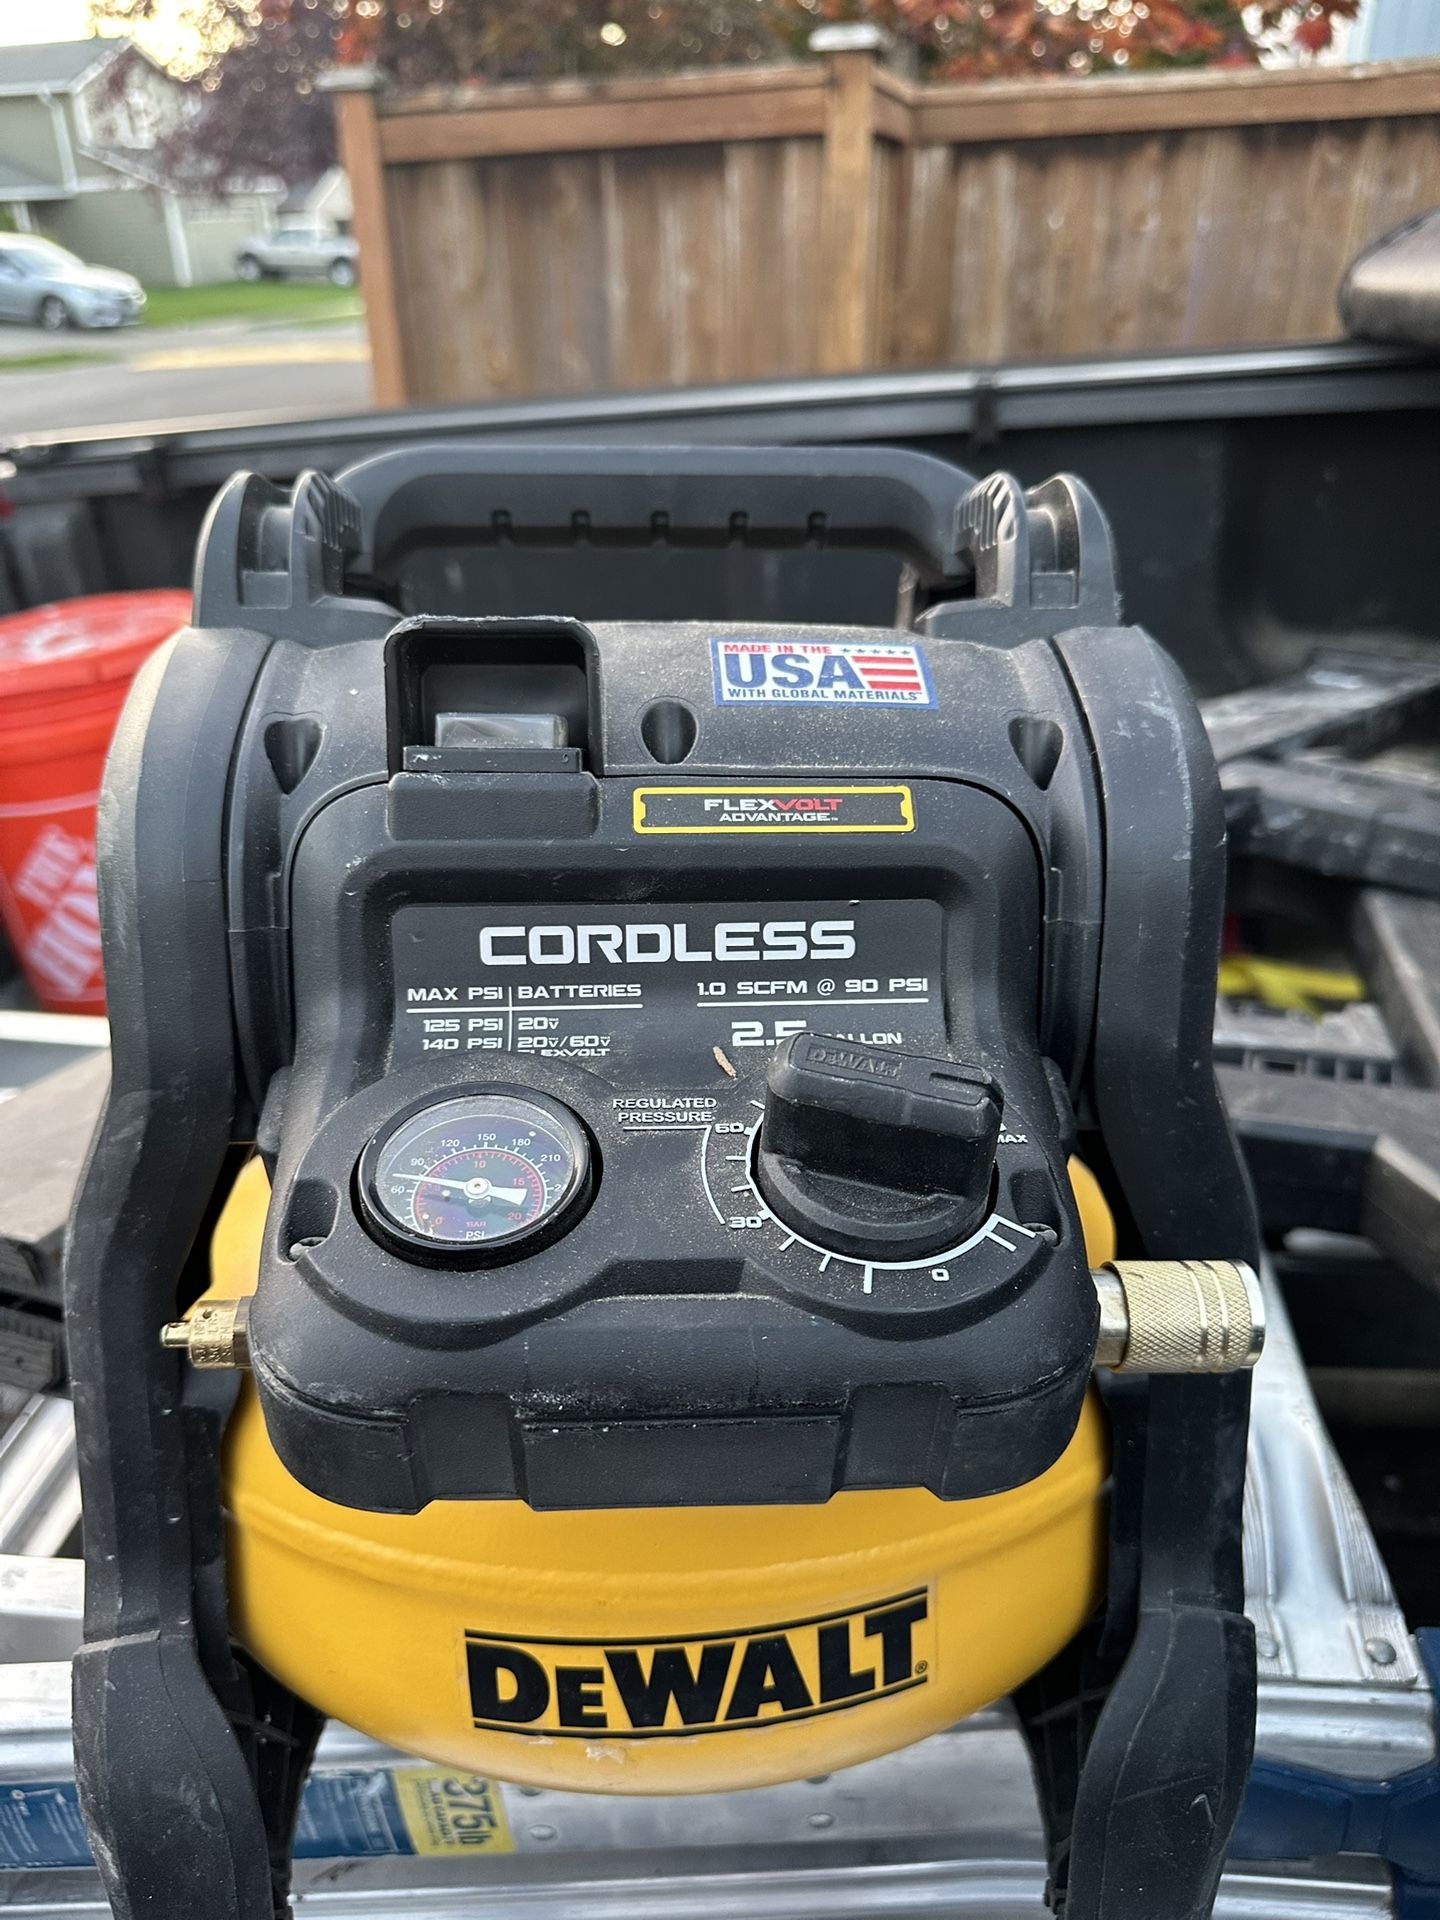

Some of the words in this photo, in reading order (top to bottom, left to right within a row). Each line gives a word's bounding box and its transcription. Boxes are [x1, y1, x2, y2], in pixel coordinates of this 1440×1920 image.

[724, 644, 772, 653] MADE
[777, 645, 794, 654] IN
[800, 645, 833, 655] THE
[723, 653, 866, 690] USA
[728, 688, 767, 699] WITH
[772, 688, 829, 699] GLOBAL
[833, 689, 918, 701] MATERIALS
[703, 798, 843, 812] FLEXVOLT
[719, 812, 831, 822] ADVANTAGE
[478, 920, 856, 966] CORDLESS
[517, 983, 642, 999] BATTERIES
[697, 981, 726, 996] 1.0
[736, 980, 808, 995] SCFM
[816, 978, 836, 996] @
[844, 978, 878, 993] 90
[889, 977, 929, 992] PSI
[407, 987, 459, 1002] MAX
[468, 986, 503, 1000] PSI
[422, 1018, 460, 1032] 125
[468, 1018, 503, 1031] PSI
[731, 1019, 807, 1047] 2.5
[421, 1038, 459, 1050] 140
[467, 1037, 503, 1049] PSI
[612, 1098, 717, 1109] REGULATED
[618, 1111, 713, 1122] PRESSURE
[714, 1122, 745, 1134] 60
[477, 1133, 497, 1141] 150
[511, 1138, 531, 1146] 180
[441, 1139, 460, 1147] 120
[410, 1158, 425, 1166] 90
[541, 1154, 561, 1162] 210
[473, 1160, 487, 1168] 10
[512, 1178, 525, 1186] 15
[390, 1185, 405, 1194] 60
[507, 1212, 522, 1220] 20
[728, 1216, 763, 1229] 30
[465, 1230, 485, 1239] PSI
[931, 1268, 950, 1282] 0
